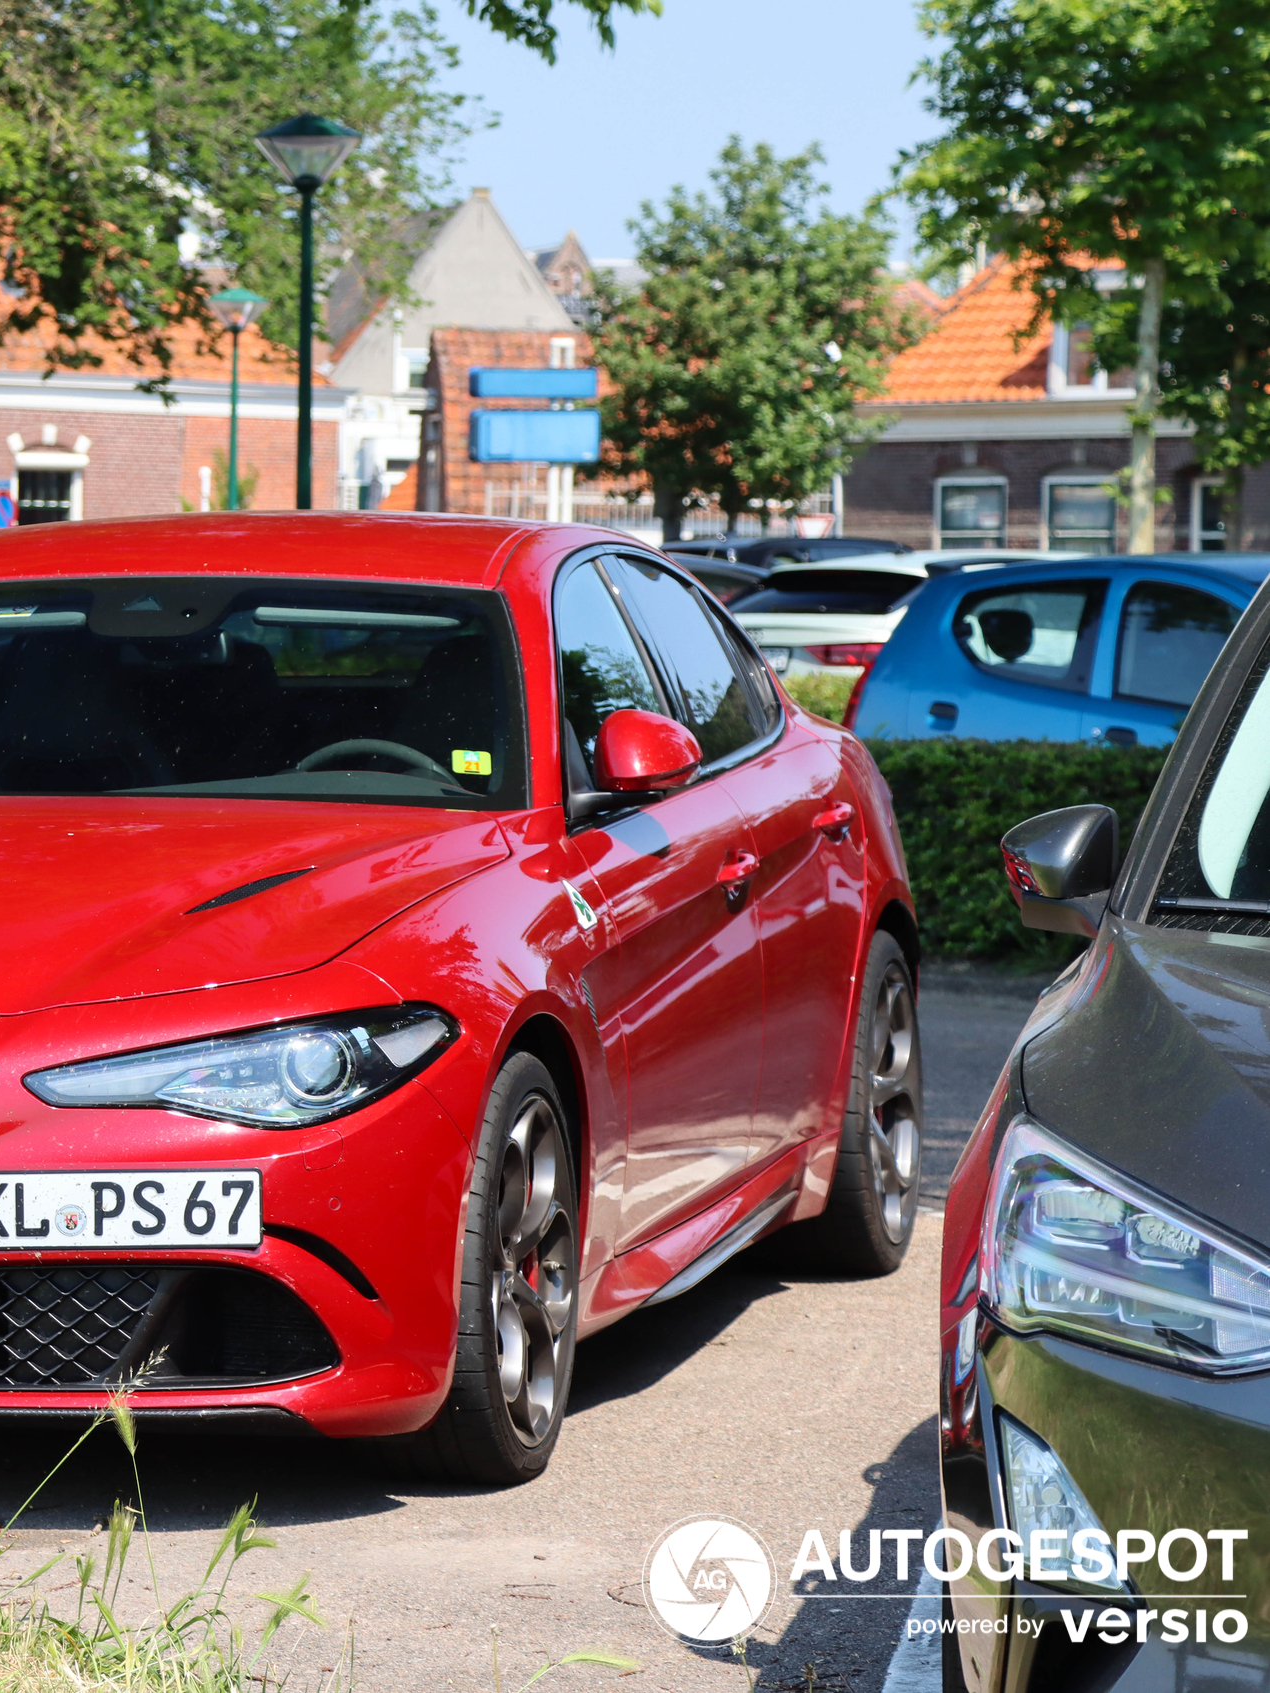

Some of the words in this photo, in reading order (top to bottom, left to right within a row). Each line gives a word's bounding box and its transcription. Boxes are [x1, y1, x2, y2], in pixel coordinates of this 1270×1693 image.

[464, 761, 480, 771] 21
[91, 1180, 167, 1236] PS
[184, 1180, 254, 1236] 67
